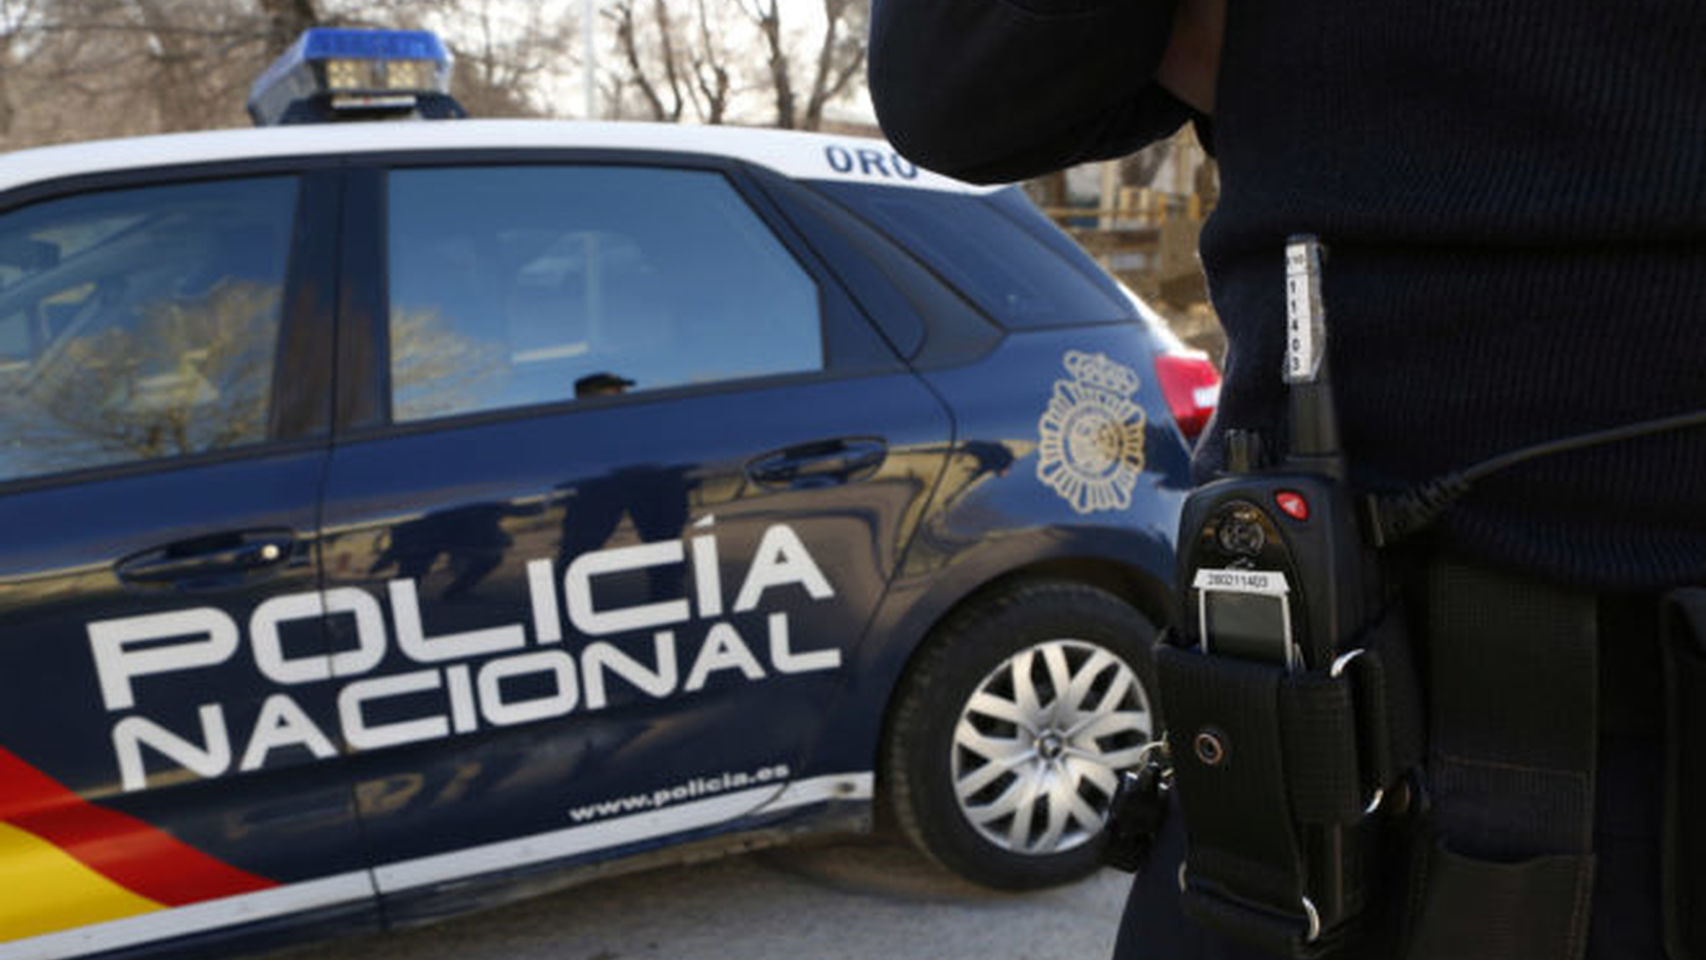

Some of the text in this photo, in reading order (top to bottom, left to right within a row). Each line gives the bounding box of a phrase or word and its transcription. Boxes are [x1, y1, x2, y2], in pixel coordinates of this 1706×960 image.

[87, 515, 835, 711] POLICÍA
[112, 612, 842, 792] NACIONAL
[569, 764, 790, 821] www.policia.es
